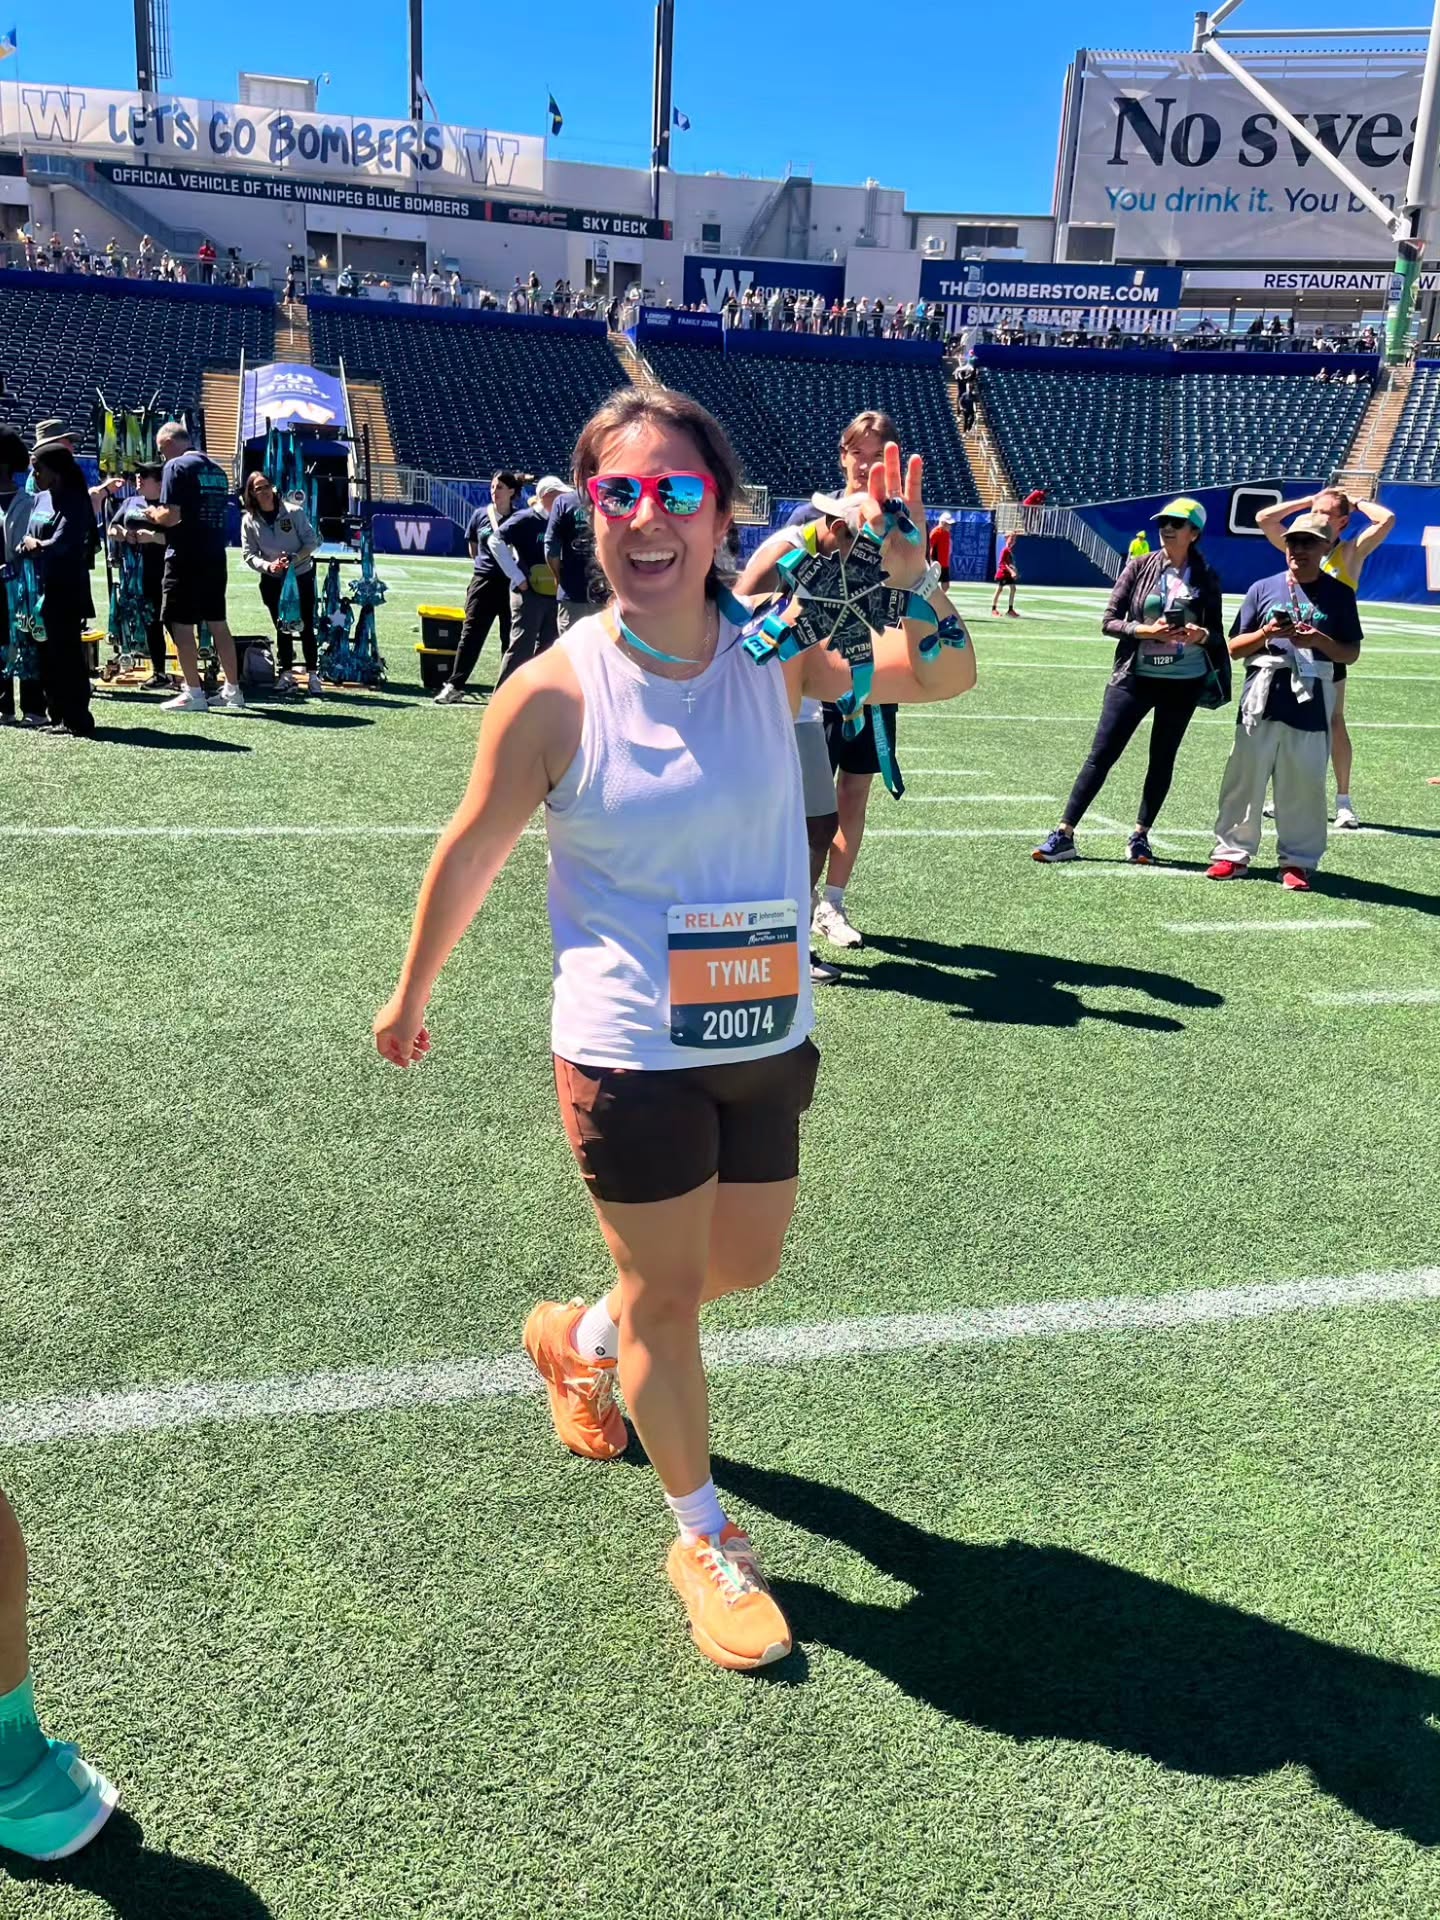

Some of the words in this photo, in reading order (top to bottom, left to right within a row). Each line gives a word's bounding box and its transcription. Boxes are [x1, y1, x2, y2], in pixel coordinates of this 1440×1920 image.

[22, 88, 86, 143] W
[108, 103, 197, 150] LET'S
[209, 111, 256, 155] GO
[267, 114, 443, 172] BOMBERS
[1107, 96, 1221, 167] No
[1238, 111, 1415, 168] swe
[462, 133, 520, 187] W
[112, 166, 177, 187] OFFICIAL
[180, 173, 239, 193] VEHICLE
[243, 179, 262, 195] OF
[264, 182, 292, 199] THE
[294, 184, 364, 206] WINNIPEG
[366, 194, 401, 209] BLUE
[404, 197, 470, 218] BOMBERS
[1105, 186, 1157, 212] You
[1165, 187, 1239, 212] drink
[1248, 187, 1275, 212] it.
[1284, 187, 1338, 212] You
[1347, 187, 1395, 213] bn
[508, 207, 569, 228] GMC
[582, 216, 609, 231] SKY
[613, 219, 648, 235] DECK
[1264, 273, 1386, 289] RESTAURANT
[967, 306, 1024, 326] SNACK
[394, 521, 431, 550] W
[852, 548, 879, 565] RELAY
[684, 912, 744, 929] RELAY
[708, 957, 772, 987] TYNAE
[702, 1005, 775, 1041] 20074
